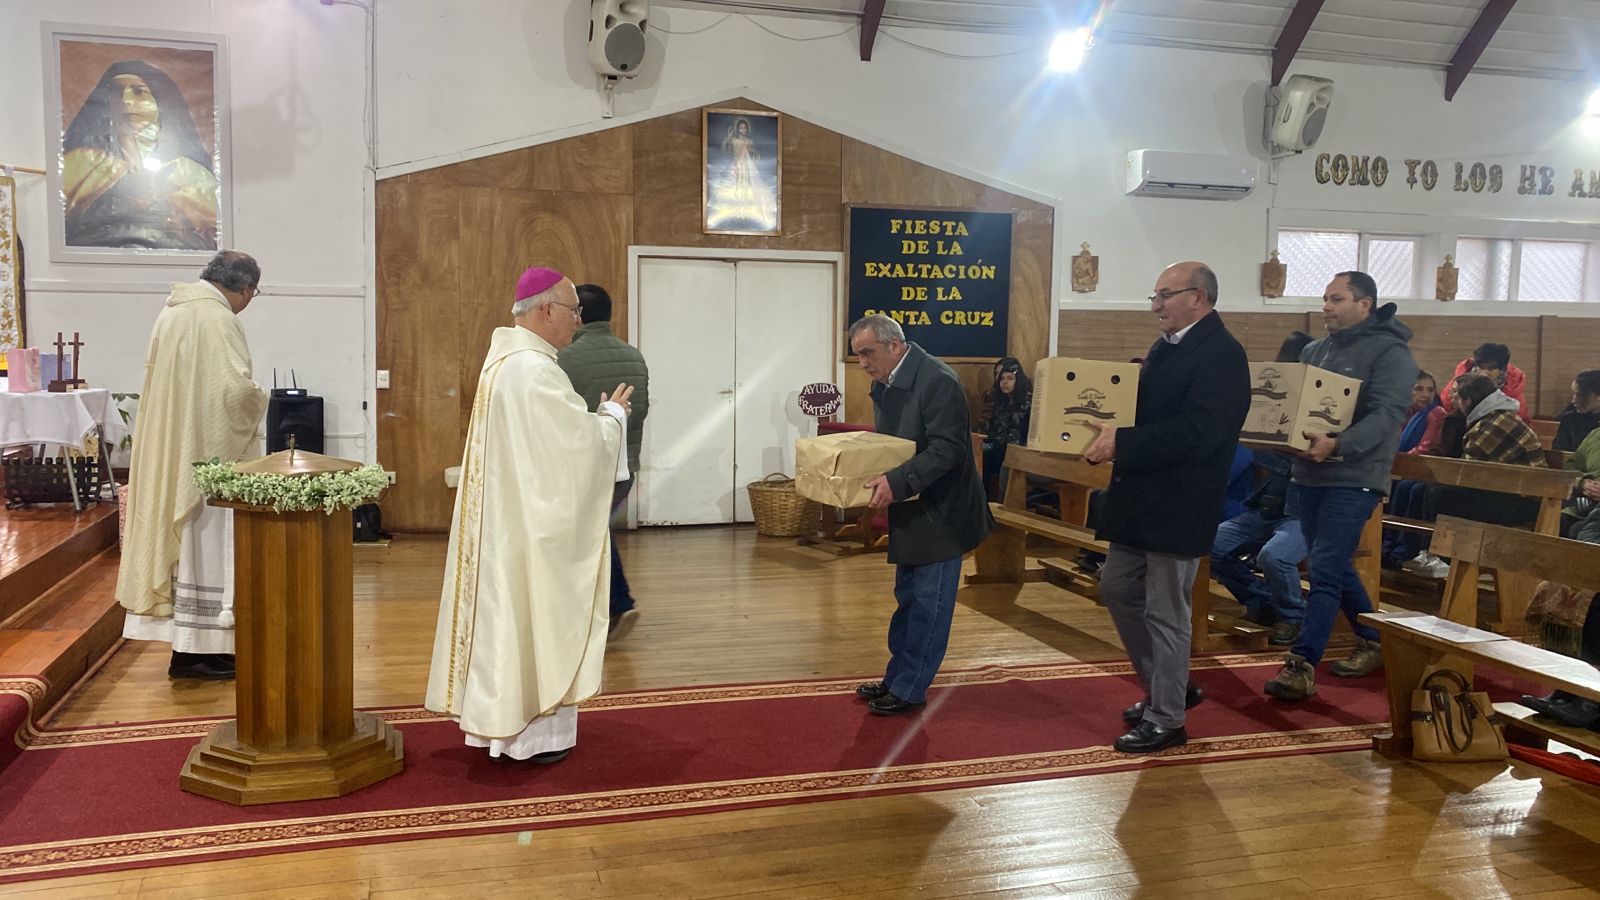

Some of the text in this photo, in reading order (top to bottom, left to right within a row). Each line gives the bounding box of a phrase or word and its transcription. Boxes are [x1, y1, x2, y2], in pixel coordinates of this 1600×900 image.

[1315, 153, 1389, 187] COMO
[1404, 159, 1438, 191] YO
[1453, 161, 1503, 193] LOS
[1517, 165, 1555, 195] HE
[891, 219, 969, 236] FIESTA
[902, 240, 963, 255] DE LA
[865, 259, 996, 280] EXALTACIÓN
[901, 287, 963, 301] DE LA
[864, 309, 994, 327] NTA CRUZ
[803, 384, 836, 395] AYUDA
